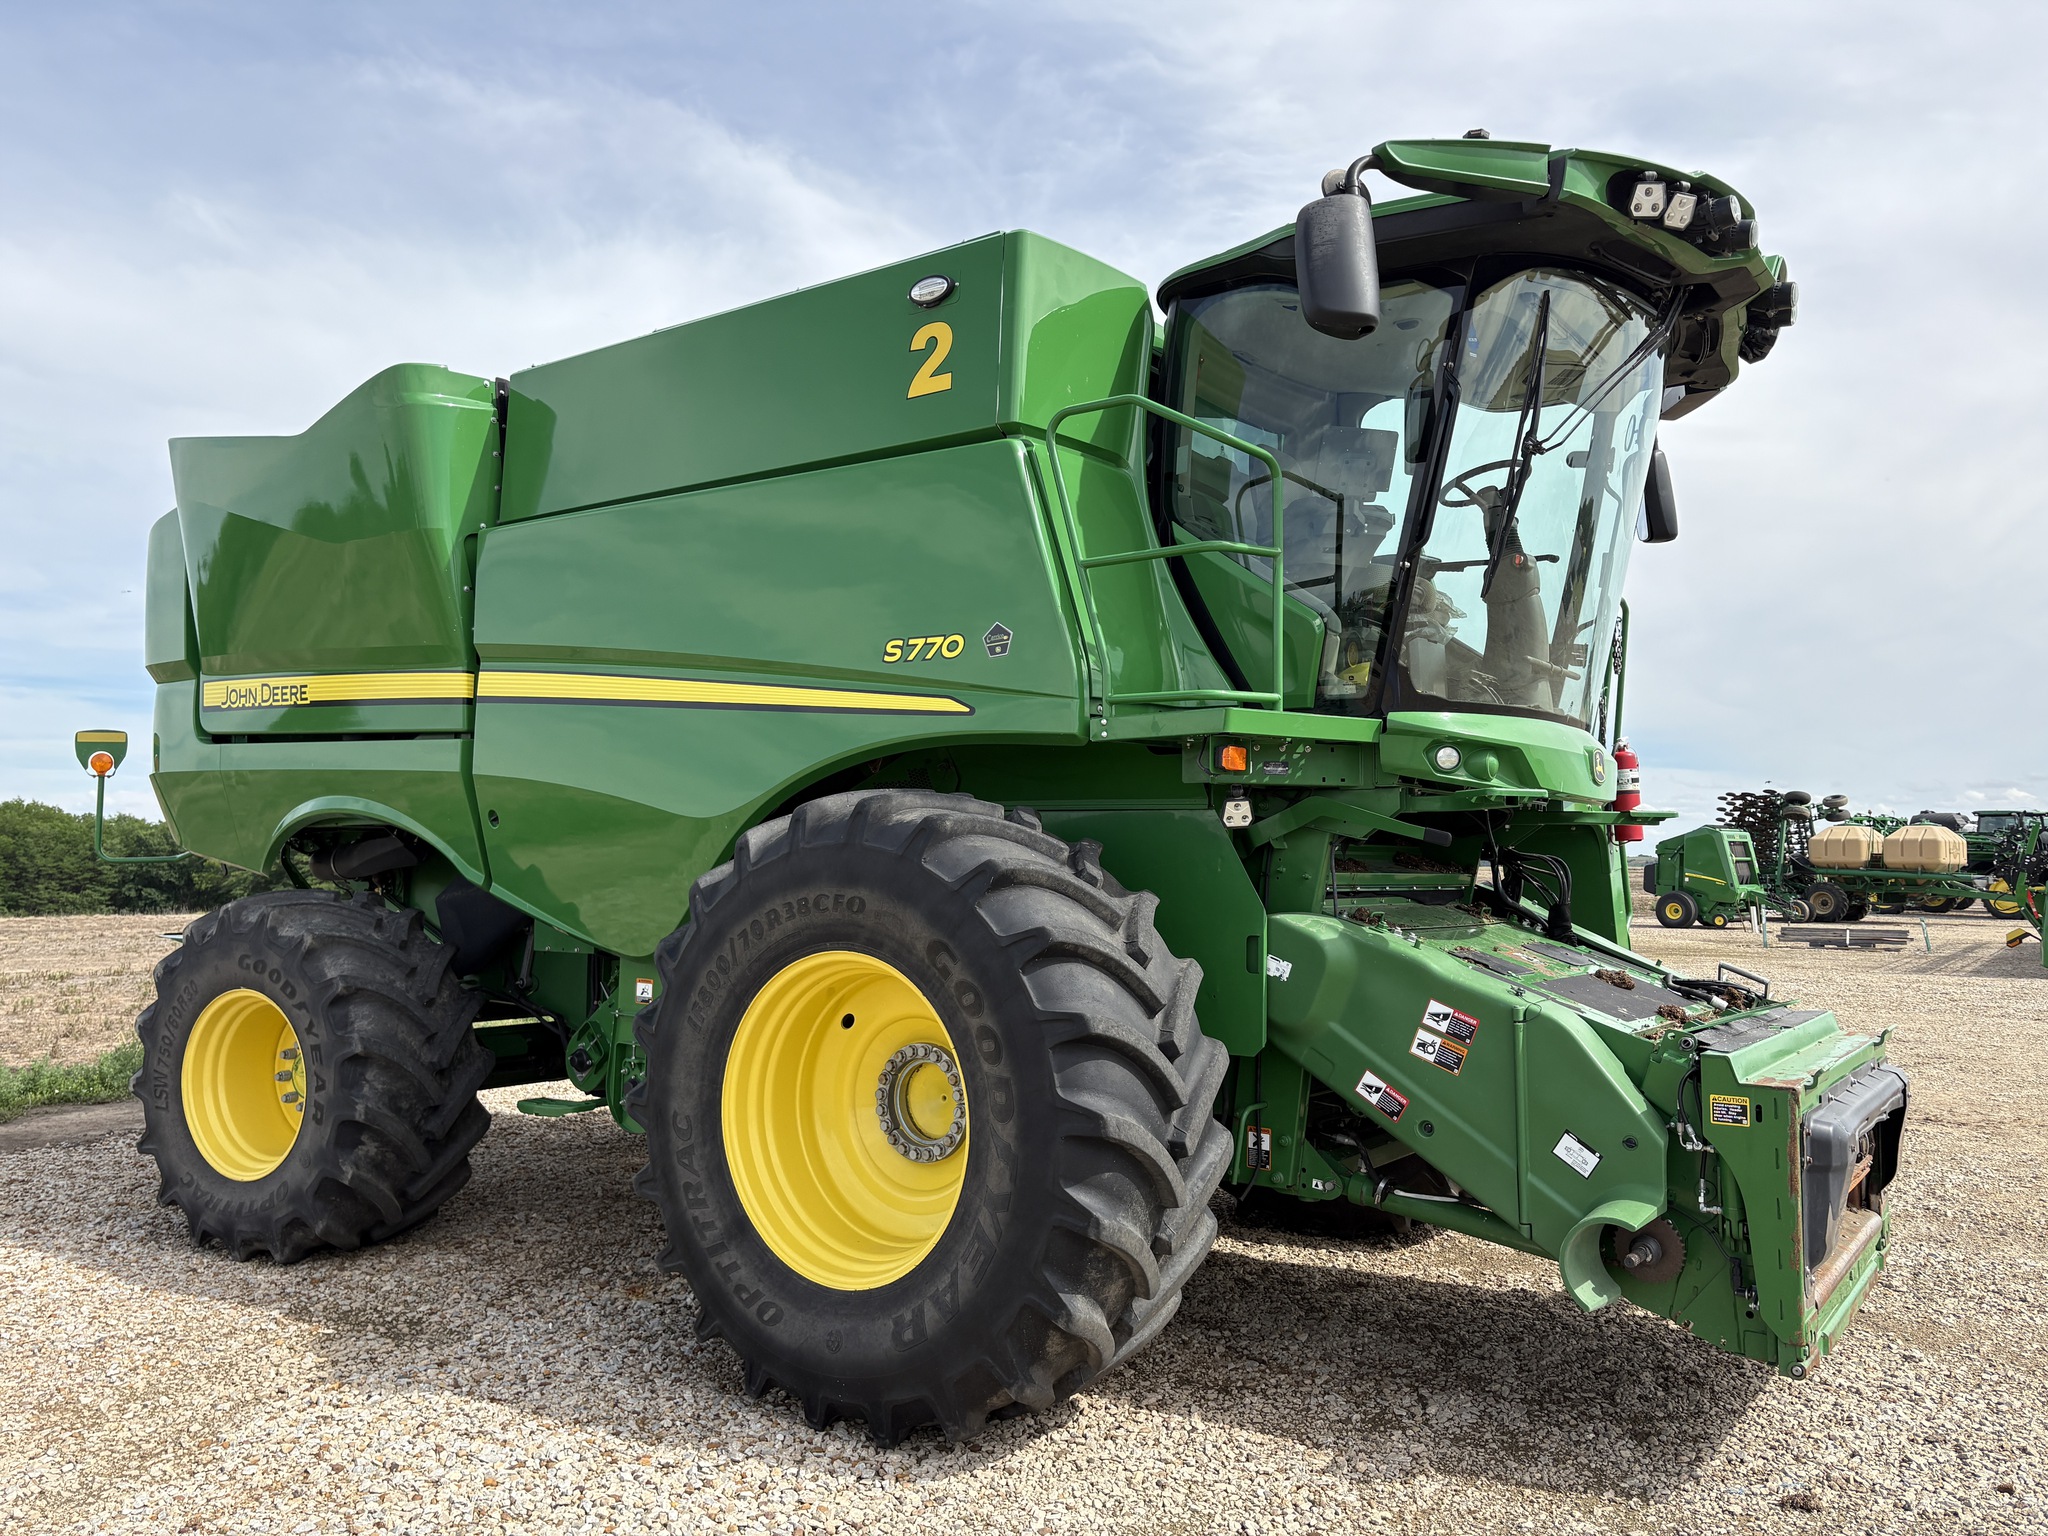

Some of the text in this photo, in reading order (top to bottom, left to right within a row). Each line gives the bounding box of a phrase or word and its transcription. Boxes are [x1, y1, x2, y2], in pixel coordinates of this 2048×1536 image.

[906, 321, 953, 400] 2
[882, 633, 965, 664] S770
[221, 683, 309, 707] JOHN DEERE
[238, 953, 327, 1127] GOODYEAR
[1716, 1095, 1748, 1105] CAUTION
[891, 939, 1018, 1352] GOODYEAR
[672, 1110, 784, 1327] OPTITRAC
